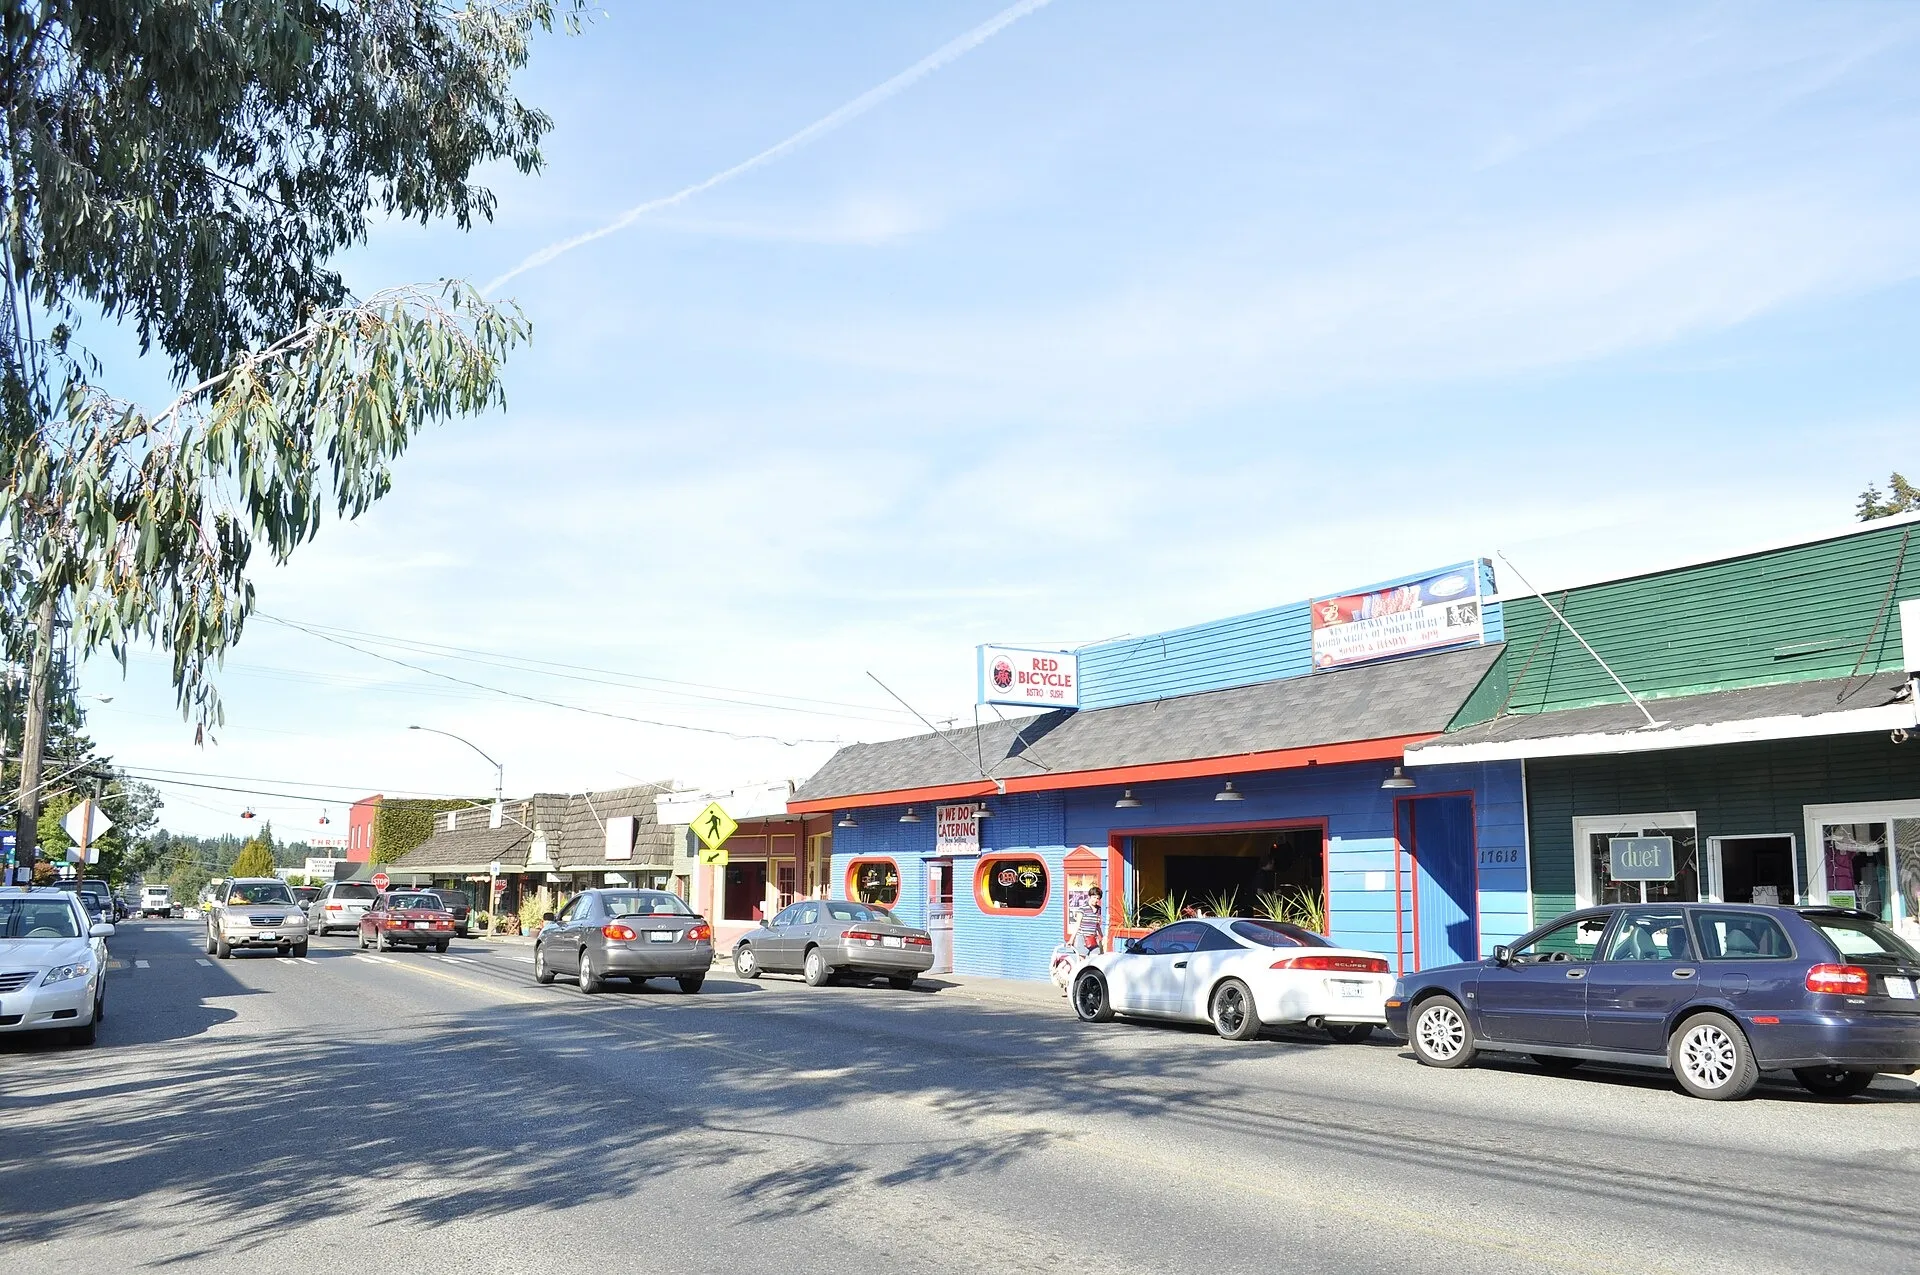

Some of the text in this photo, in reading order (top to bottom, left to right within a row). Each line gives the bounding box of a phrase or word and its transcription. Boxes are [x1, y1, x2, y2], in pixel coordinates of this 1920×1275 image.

[1383, 623, 1413, 636] POKER
[1032, 658, 1058, 672] RED
[1018, 671, 1072, 687] BICYCLE
[1026, 688, 1064, 699] BISTRO SUSHI
[945, 806, 969, 821] WE DO
[938, 822, 976, 837] CATERING
[1480, 850, 1518, 864] 17618
[1621, 841, 1662, 868] duet
